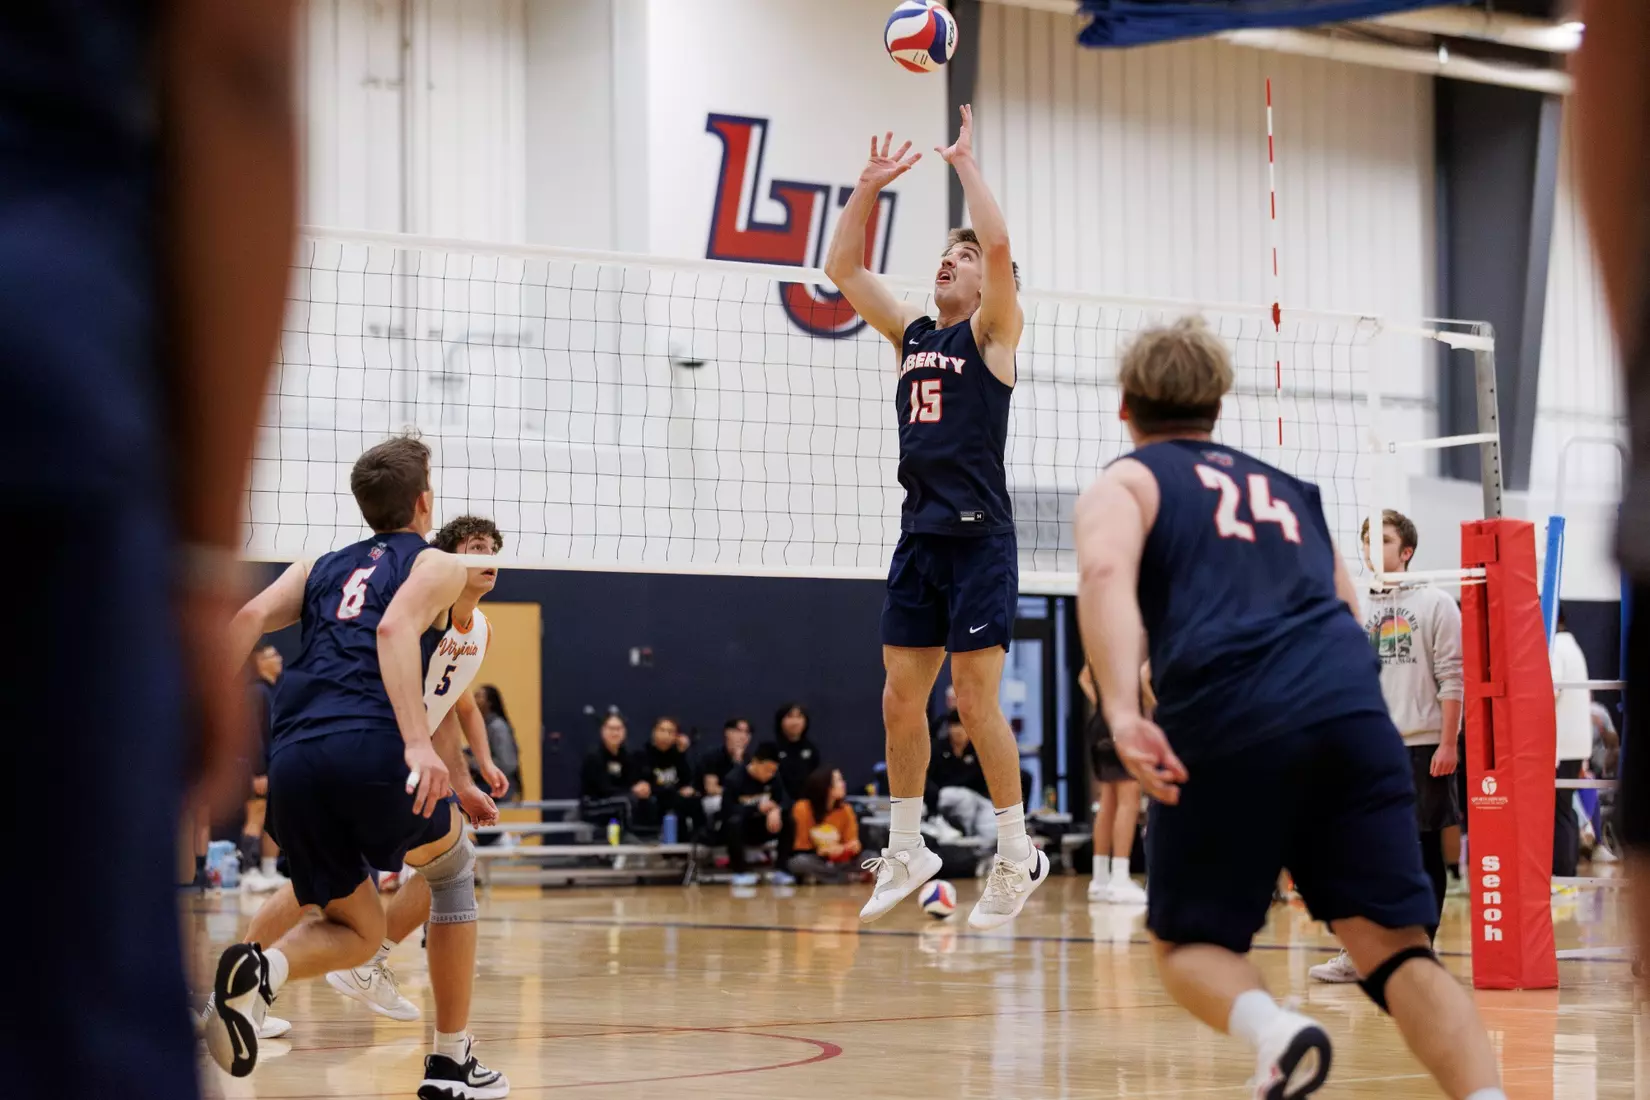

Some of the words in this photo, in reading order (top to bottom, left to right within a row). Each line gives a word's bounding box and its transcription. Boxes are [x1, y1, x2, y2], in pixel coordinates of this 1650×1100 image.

[705, 112, 897, 338] LU
[908, 378, 943, 424] 15
[1193, 463, 1302, 545] 24
[336, 565, 378, 620] 6
[439, 637, 479, 661] Virginia
[434, 664, 457, 697] 5
[1481, 855, 1503, 942] senoh
